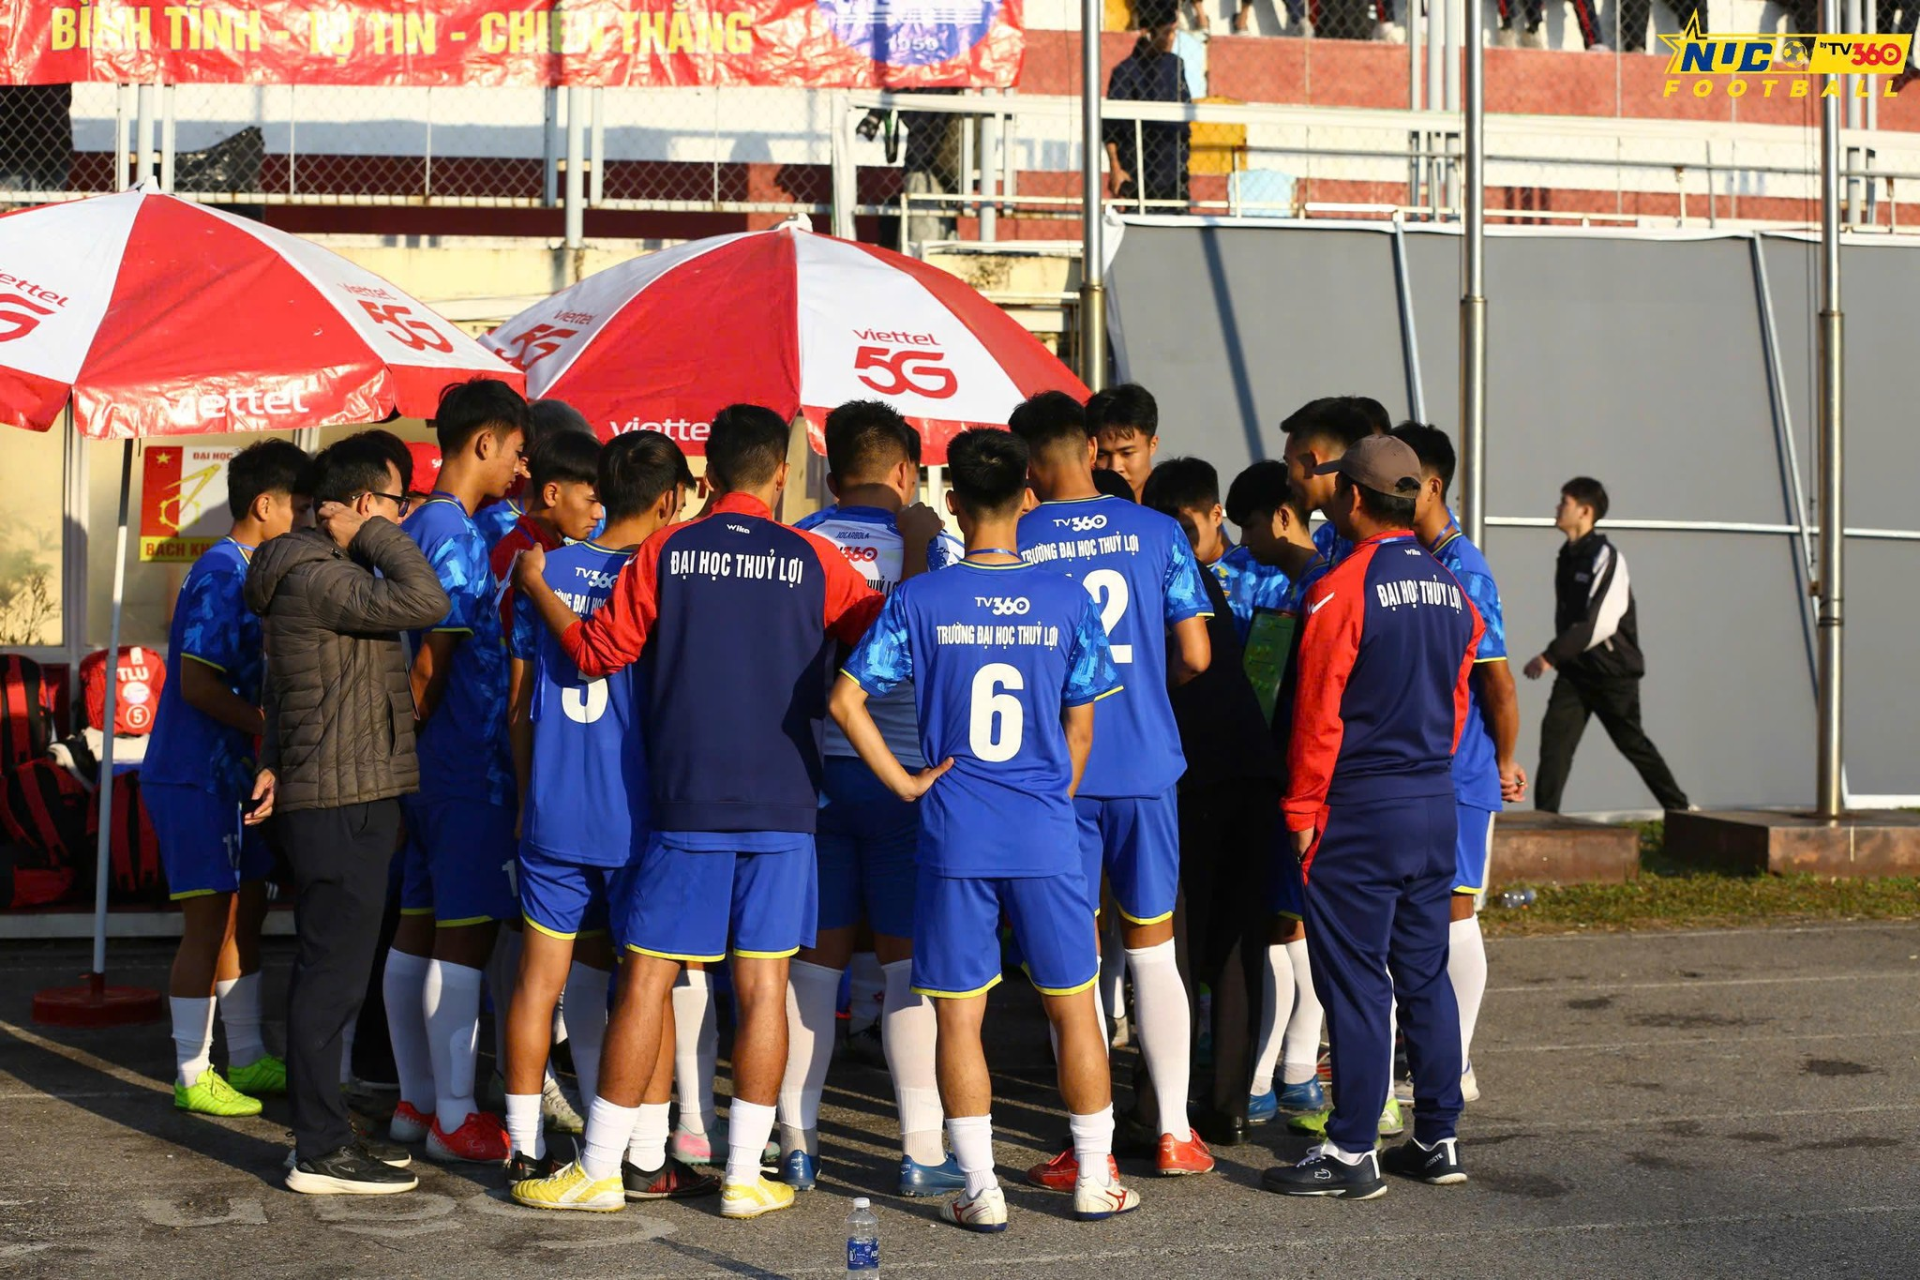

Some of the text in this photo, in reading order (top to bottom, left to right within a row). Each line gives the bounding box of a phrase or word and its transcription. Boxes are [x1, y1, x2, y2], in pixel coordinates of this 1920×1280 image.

[368, 12, 436, 55] TIN
[0, 268, 69, 308] ettel
[357, 299, 454, 354] 5G
[552, 308, 599, 326] viettel
[493, 322, 579, 375] 5G
[853, 328, 942, 346] viettel
[854, 345, 958, 399] 5G
[609, 416, 716, 442] viette
[1053, 514, 1108, 533] TV360
[670, 550, 696, 580] ĐẠI
[699, 550, 732, 581] HỌC
[778, 556, 804, 589] LỢI
[975, 596, 1031, 616] TV360
[1376, 581, 1402, 612] ĐẠI
[976, 625, 994, 650] ĐẠI
[995, 625, 1016, 650] HỌC
[117, 665, 150, 683] TLU
[132, 708, 144, 724] 5
[970, 663, 1025, 763] 6
